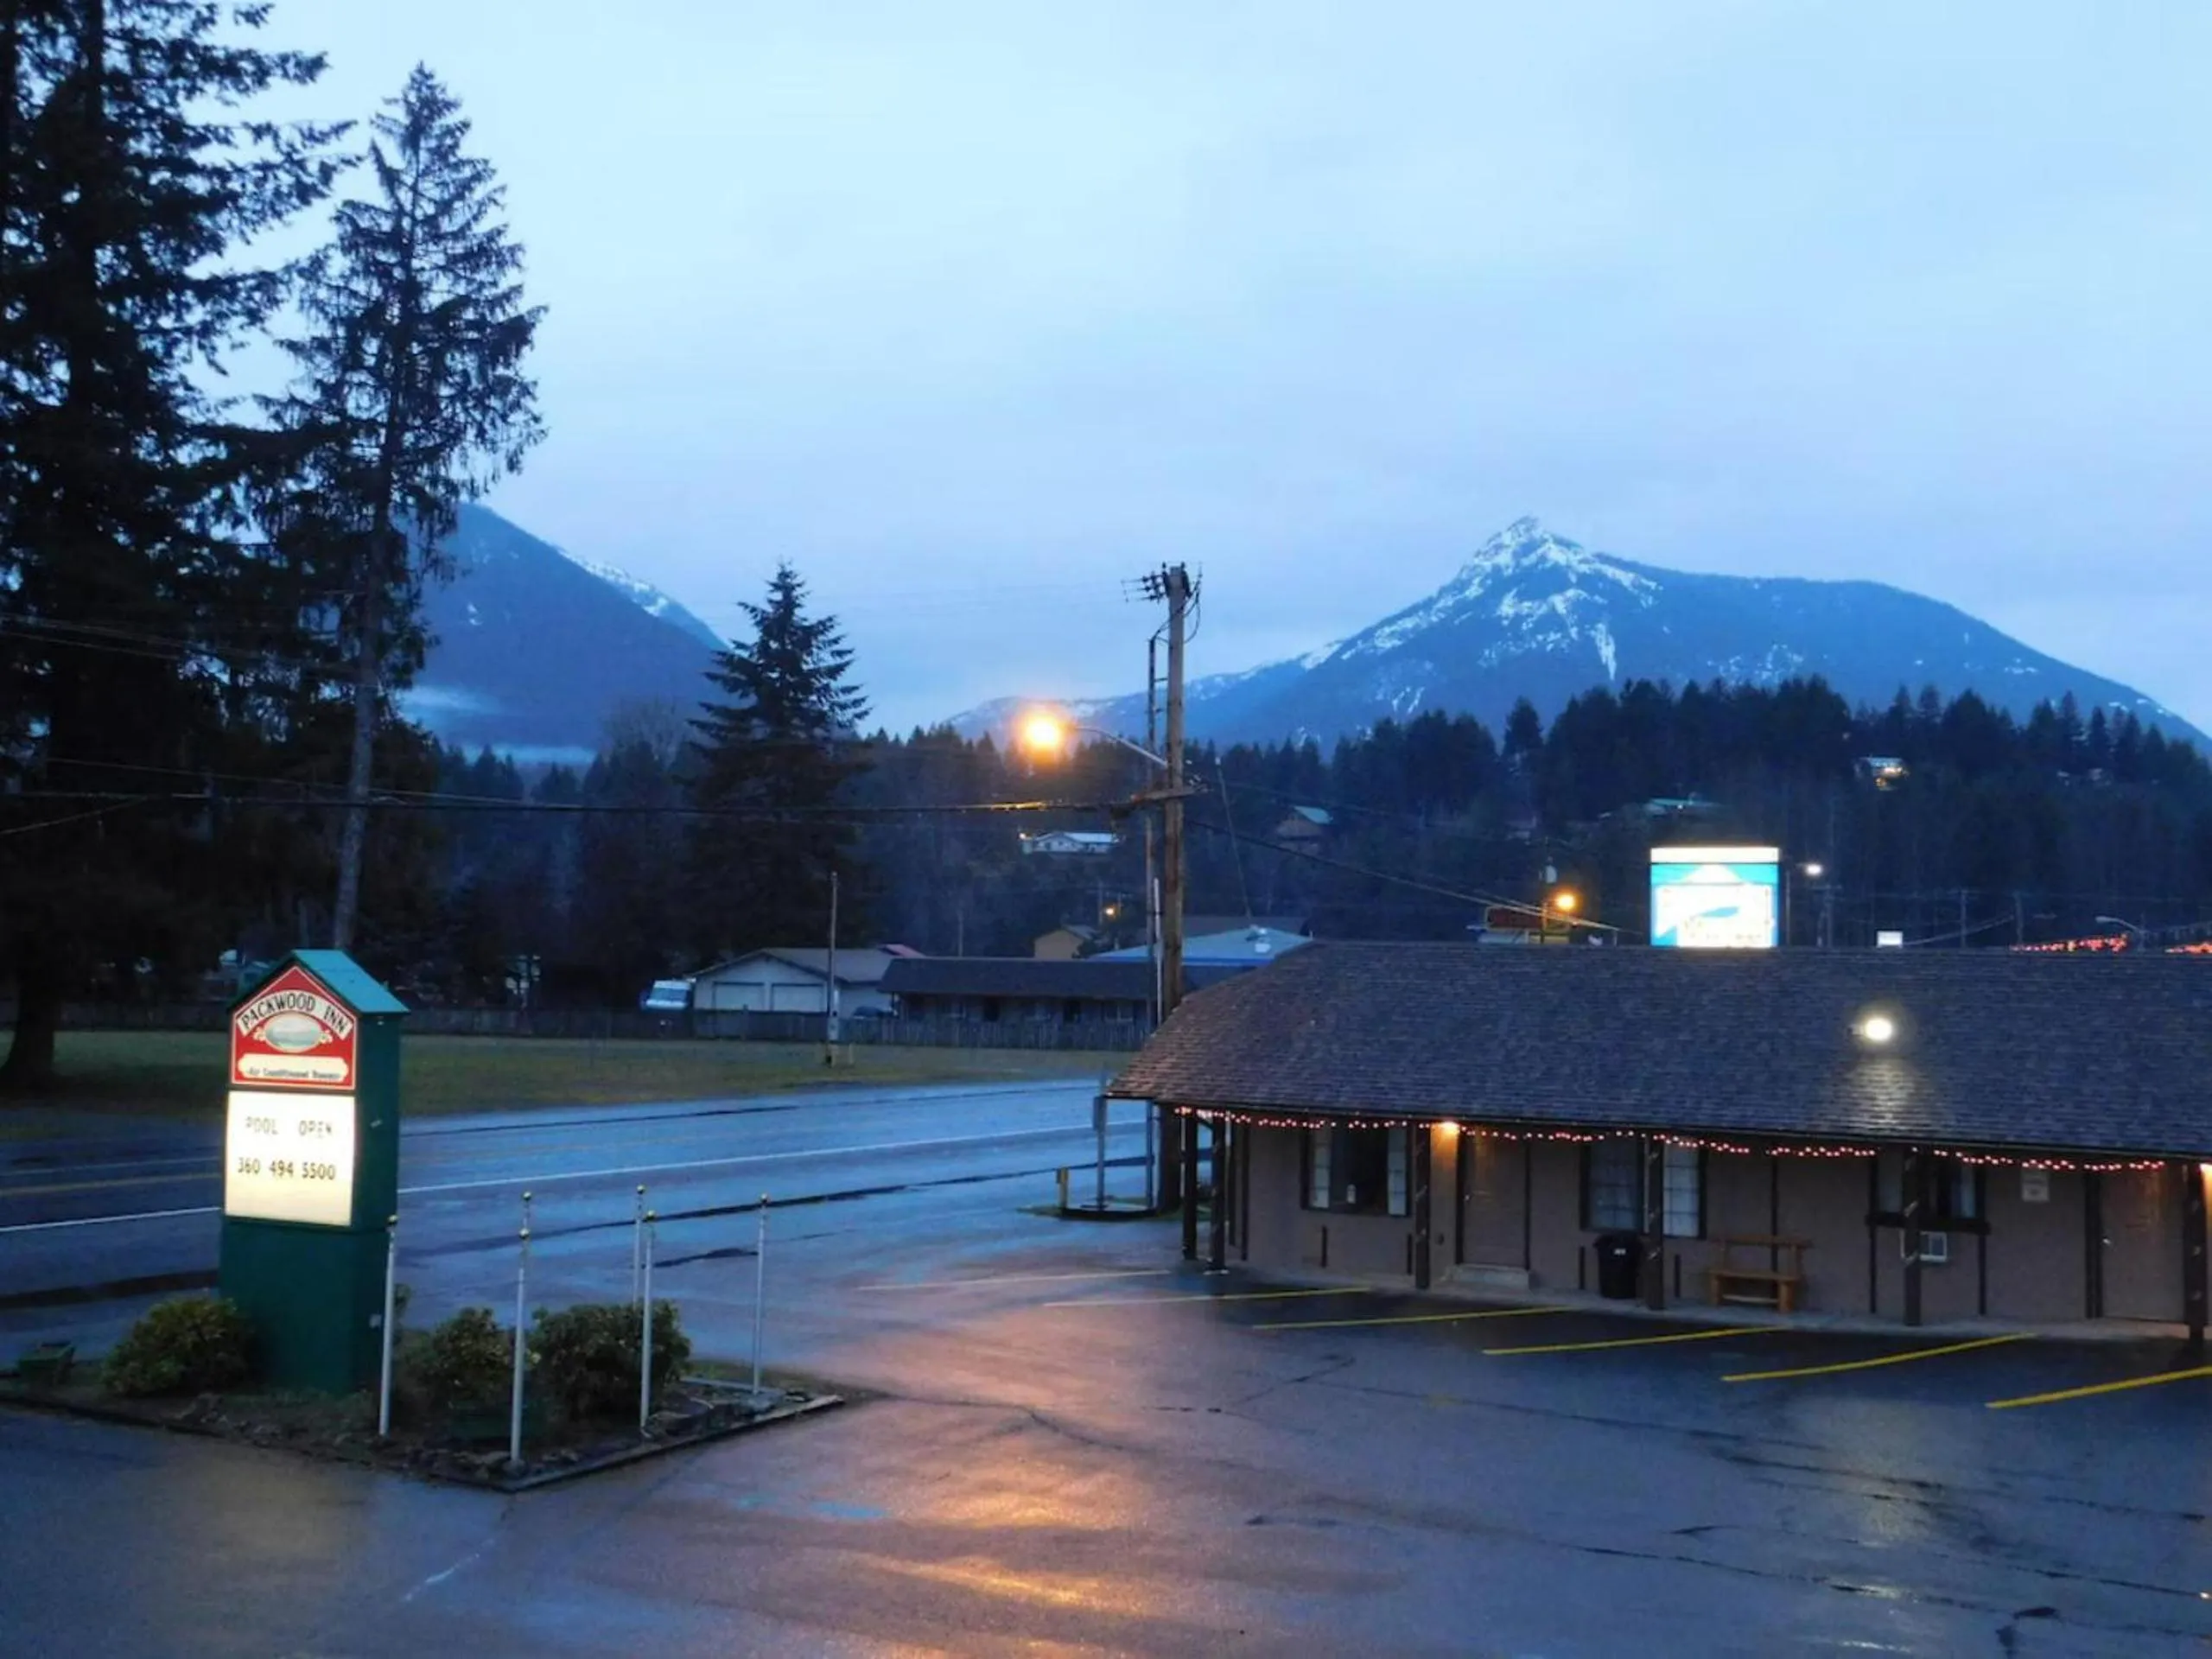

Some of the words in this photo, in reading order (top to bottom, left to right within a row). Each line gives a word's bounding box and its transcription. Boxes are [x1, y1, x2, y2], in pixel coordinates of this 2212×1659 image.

[241, 993, 316, 1030] PACKWOOD
[323, 1006, 348, 1033] INN
[246, 1116, 278, 1135] POOL
[238, 1157, 260, 1174] 360
[270, 1160, 294, 1177] 494
[302, 1162, 335, 1180] 5500
